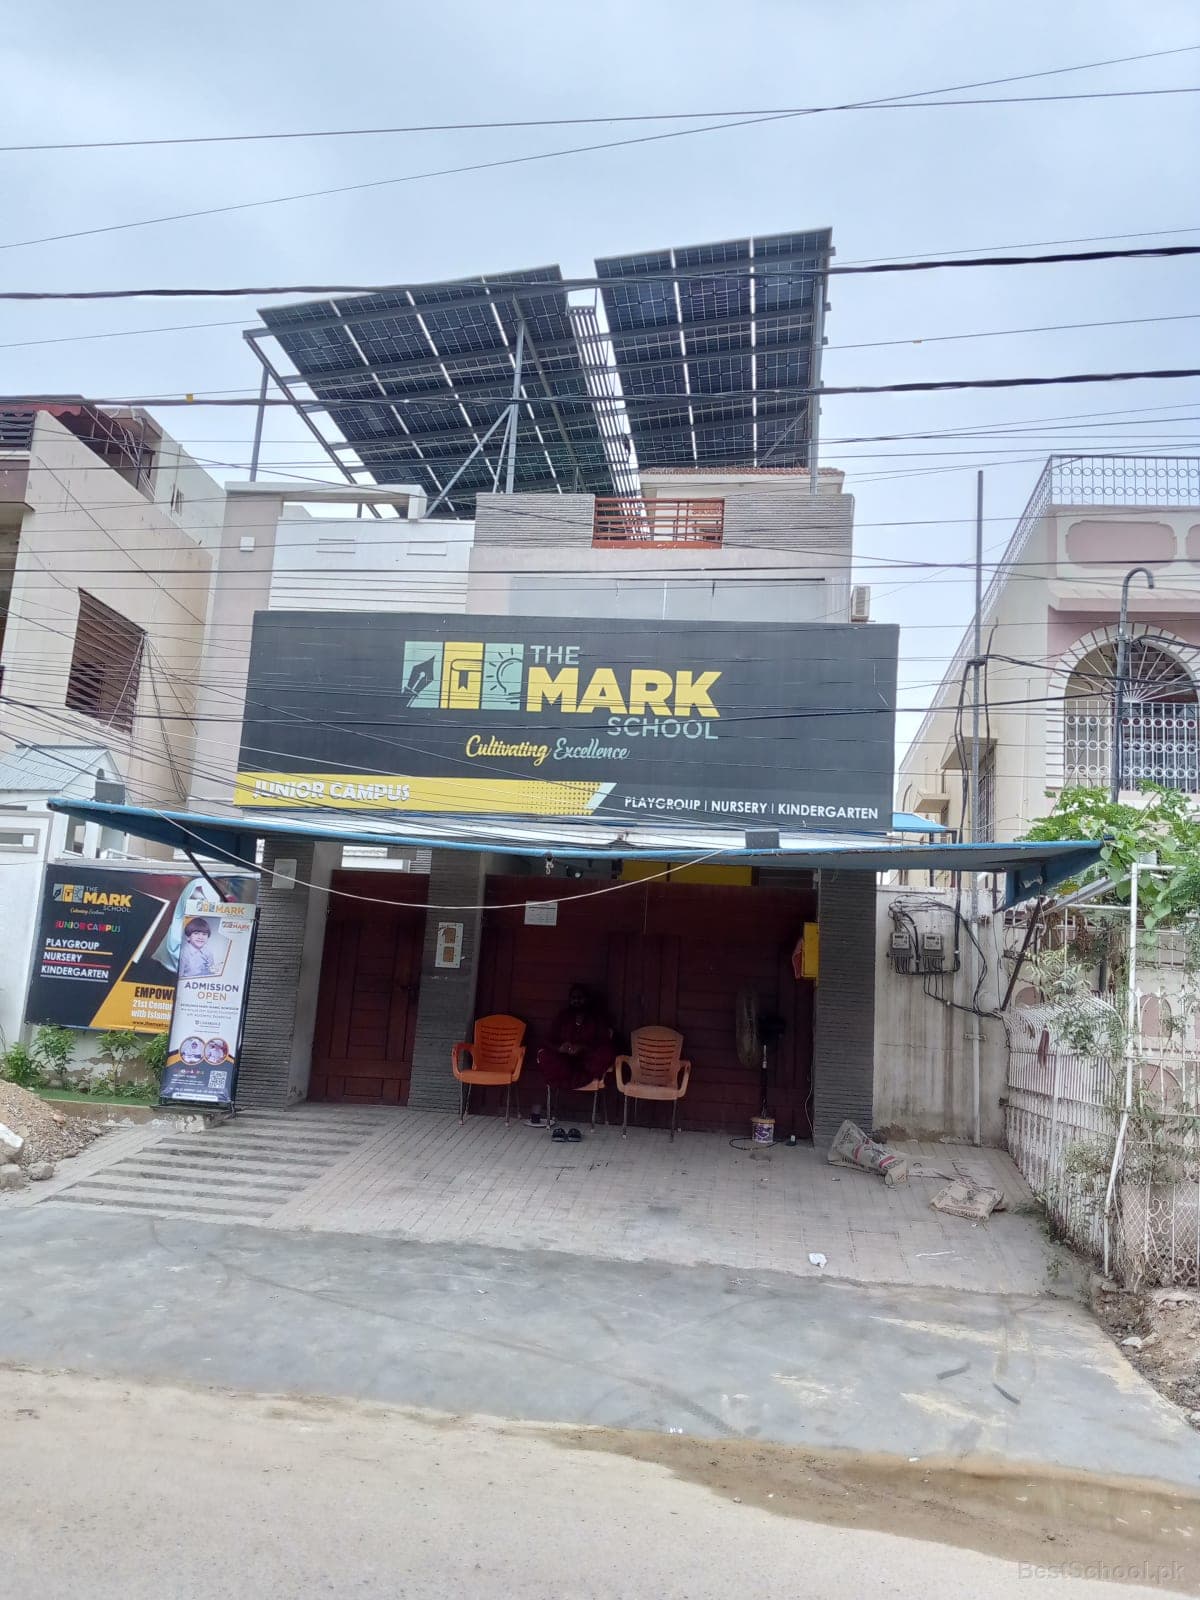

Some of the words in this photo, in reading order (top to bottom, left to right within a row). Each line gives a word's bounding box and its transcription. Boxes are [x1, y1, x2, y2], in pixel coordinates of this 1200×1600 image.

[530, 645, 580, 665] THE
[526, 667, 722, 718] MARK
[607, 717, 719, 740] SCHOOL
[466, 735, 551, 766] Cultivating
[553, 737, 630, 760] Excellence
[252, 780, 325, 799] JUNIOR
[329, 782, 410, 801] CAMPUS
[624, 796, 701, 811] PLAYGROUP
[711, 800, 768, 815] NURSERY
[778, 803, 879, 820] KINDERGARTEN
[83, 891, 132, 908] MARK
[103, 905, 131, 913] SCHOOL
[216, 904, 246, 915] MARK
[46, 938, 100, 950] PLAYGROUP
[43, 951, 82, 963] NURSERY
[41, 965, 109, 979] KINDERGARTEN
[134, 986, 175, 1001] EMPOW
[184, 981, 240, 993] ADMISSION
[197, 991, 227, 1001] OPEN
